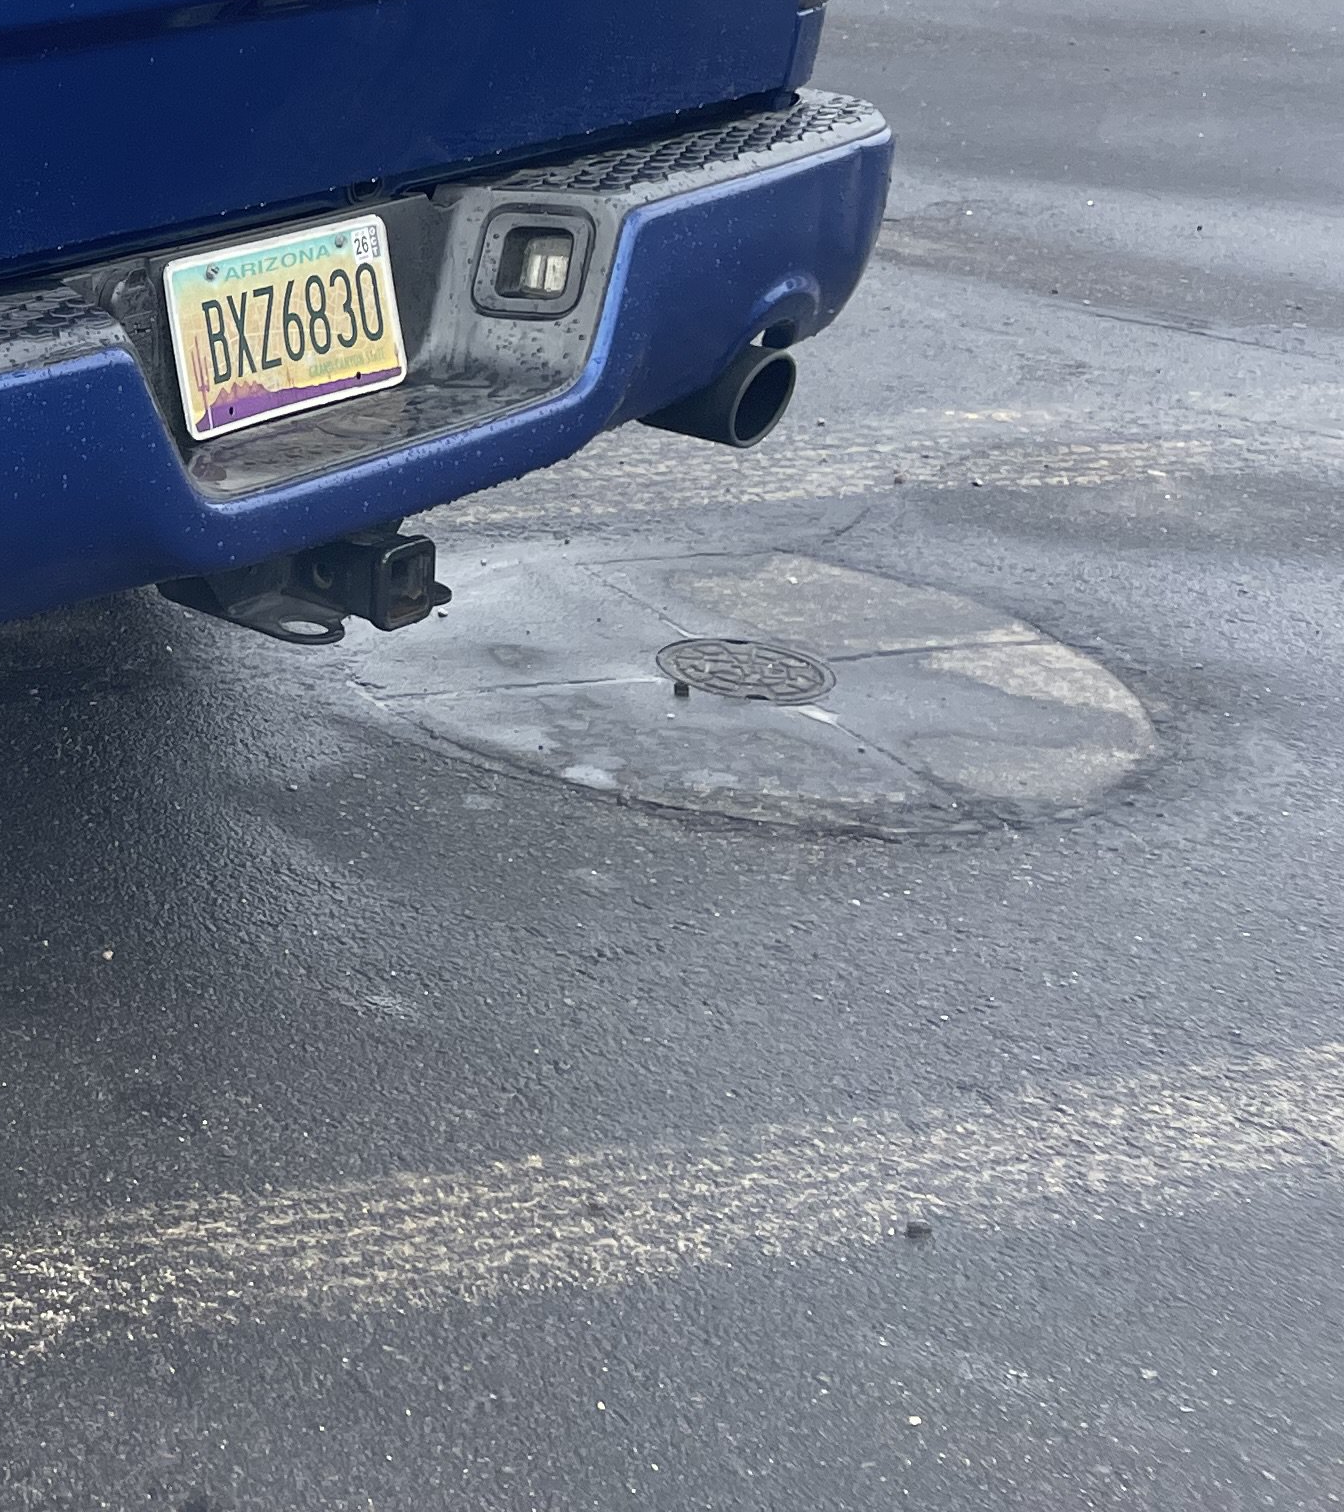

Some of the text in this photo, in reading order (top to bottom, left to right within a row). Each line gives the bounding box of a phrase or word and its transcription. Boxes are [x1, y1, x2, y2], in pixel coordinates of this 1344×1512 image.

[225, 245, 330, 281] ARIZONA
[354, 236, 369, 255] 26
[201, 262, 385, 385] BXZ6830
